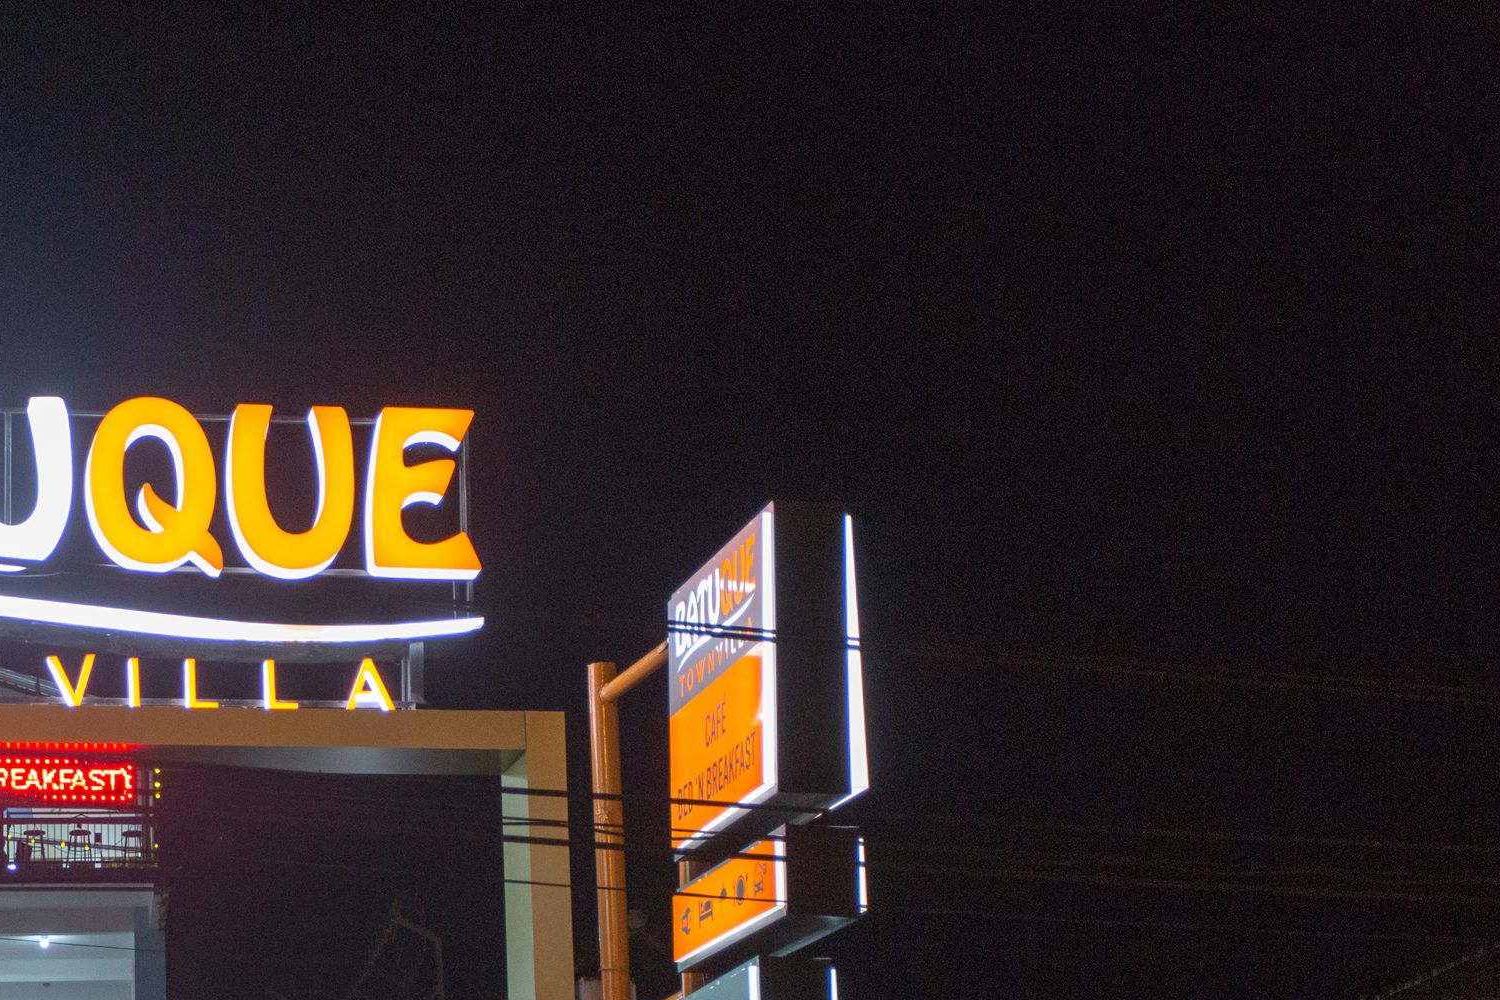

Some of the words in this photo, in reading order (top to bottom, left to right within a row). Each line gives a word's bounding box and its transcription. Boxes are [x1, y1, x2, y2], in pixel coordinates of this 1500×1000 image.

[674, 533, 756, 658] BATUQUE
[46, 653, 397, 711] VILLA
[703, 693, 727, 748] CAFÉ
[677, 781, 694, 821] BED
[706, 731, 757, 801] BREAKFAST
